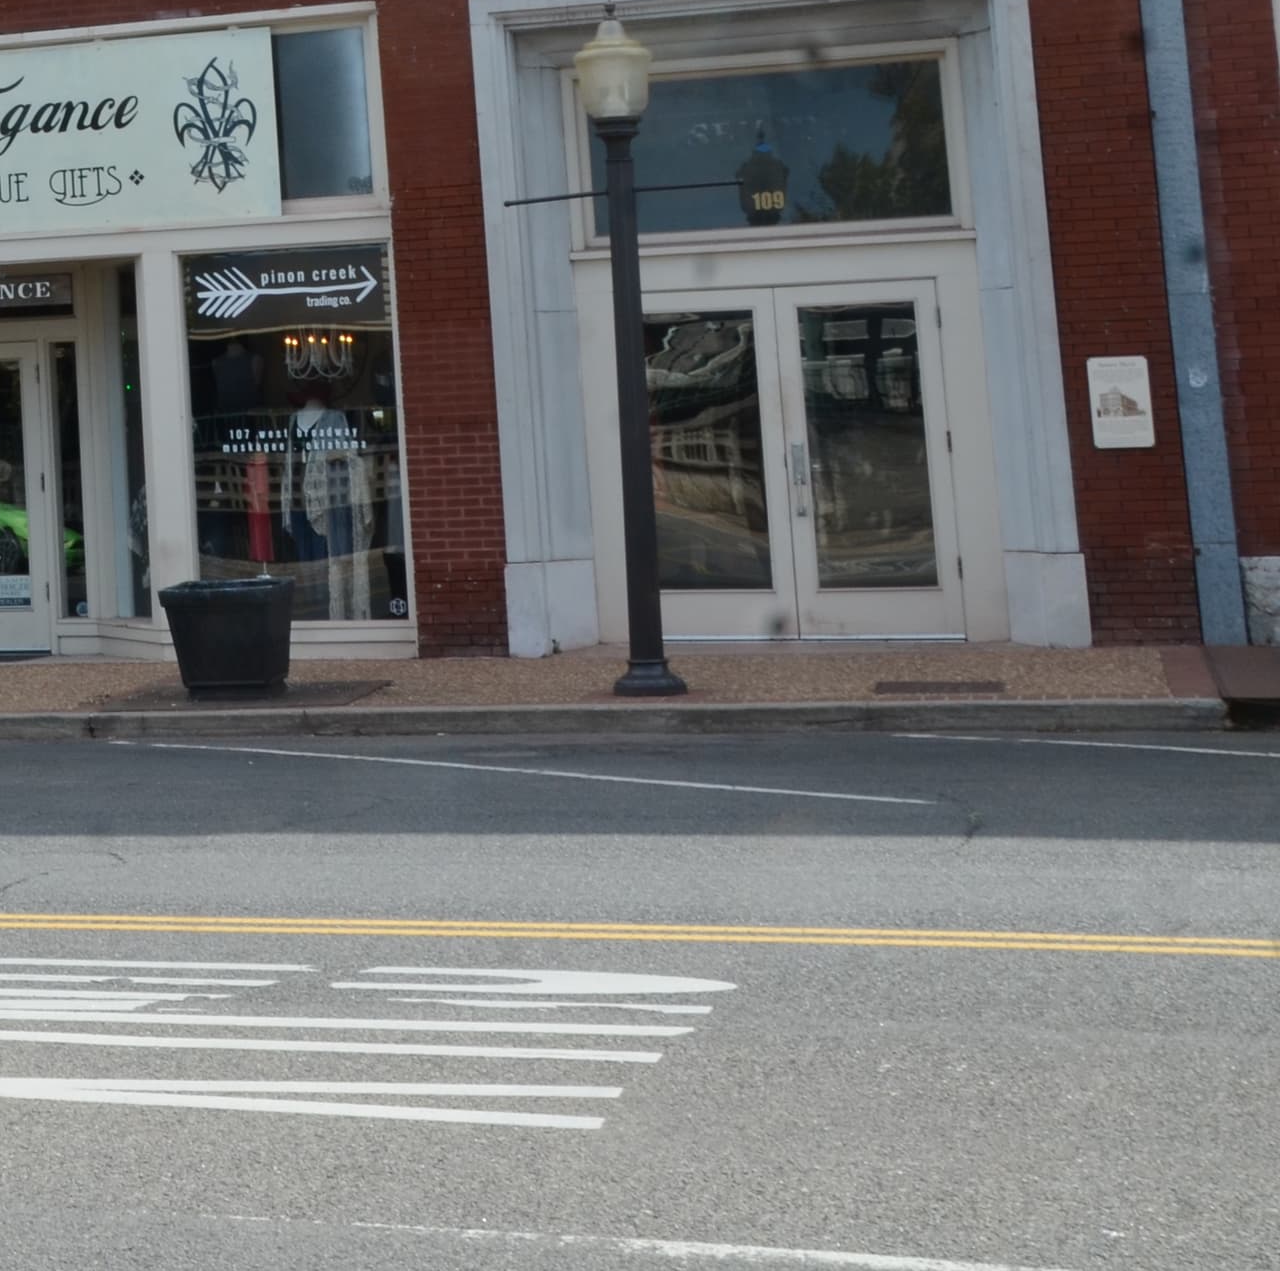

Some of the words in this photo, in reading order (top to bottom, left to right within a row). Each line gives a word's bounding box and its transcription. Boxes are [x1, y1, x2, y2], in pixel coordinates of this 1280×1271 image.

[49, 165, 123, 207] GIFTS
[752, 191, 785, 211] 109
[260, 269, 305, 286] pinon
[312, 265, 357, 281] creek
[306, 295, 338, 308] trading
[339, 295, 352, 306] co.
[229, 428, 251, 440] 107
[258, 428, 289, 440] west
[297, 427, 358, 439] broadway
[222, 441, 285, 453] muskogee
[306, 439, 367, 451] oklahoma
